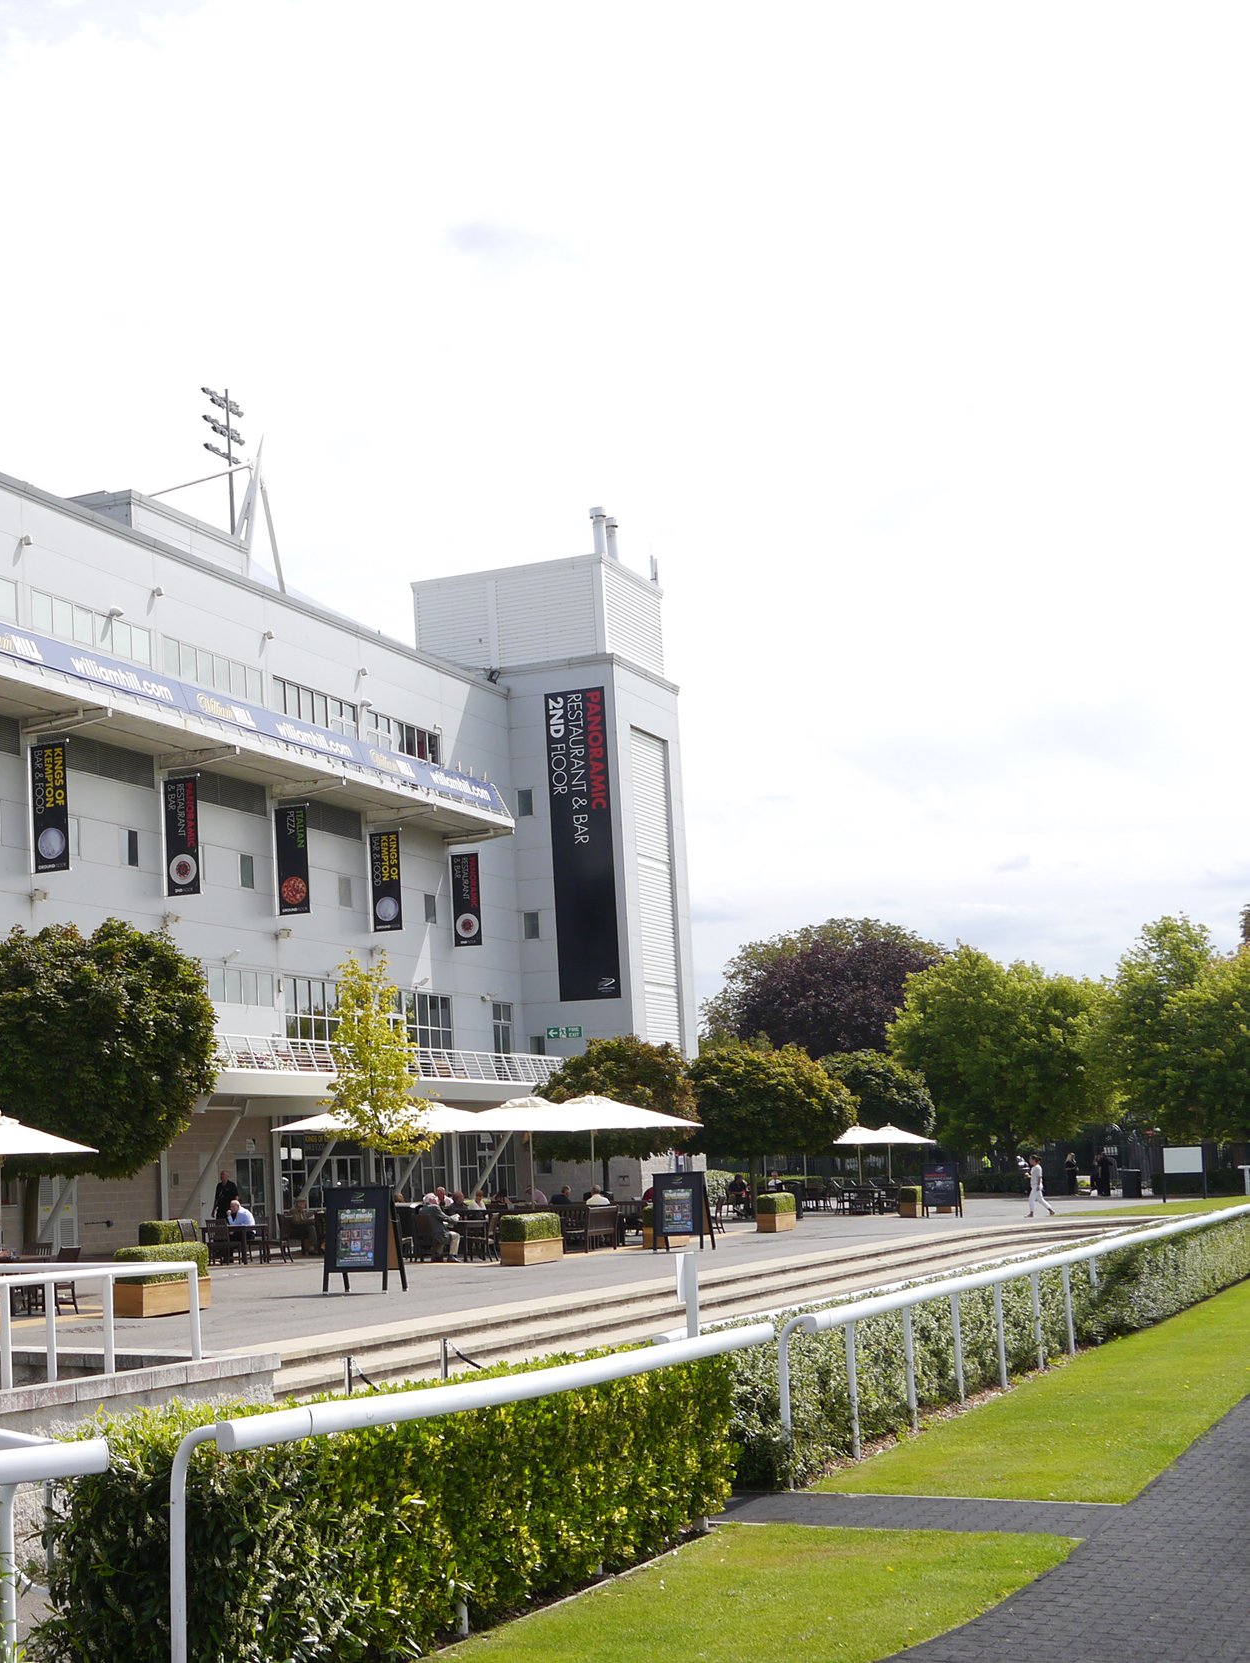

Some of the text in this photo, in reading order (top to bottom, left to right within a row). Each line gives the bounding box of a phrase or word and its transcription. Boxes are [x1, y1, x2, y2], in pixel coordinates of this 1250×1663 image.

[11, 634, 44, 661] HILL
[70, 657, 174, 702] williamhill.com
[231, 705, 257, 728] HILL
[34, 750, 43, 769] BAR
[275, 722, 354, 758] williamhill.com
[548, 697, 568, 796] 2ND FLOOR
[586, 691, 607, 810] PANORAMIC
[44, 748, 54, 808] KEMPTON
[54, 747, 65, 806] KINGS OF
[566, 693, 590, 844] RESTAURANT & BAR
[35, 782, 44, 815] FOOD
[168, 794, 176, 811] BAR
[176, 783, 186, 837] RESTAURANT
[185, 782, 196, 848] PANORAMIC
[287, 810, 296, 836] PIZZA
[295, 810, 305, 848] ITALIAN
[372, 836, 380, 852] BAR
[373, 861, 382, 887] FOOD
[381, 835, 390, 881] KEMPTON
[389, 834, 399, 880] KINGS OF
[469, 856, 478, 908] PANORAMIC
